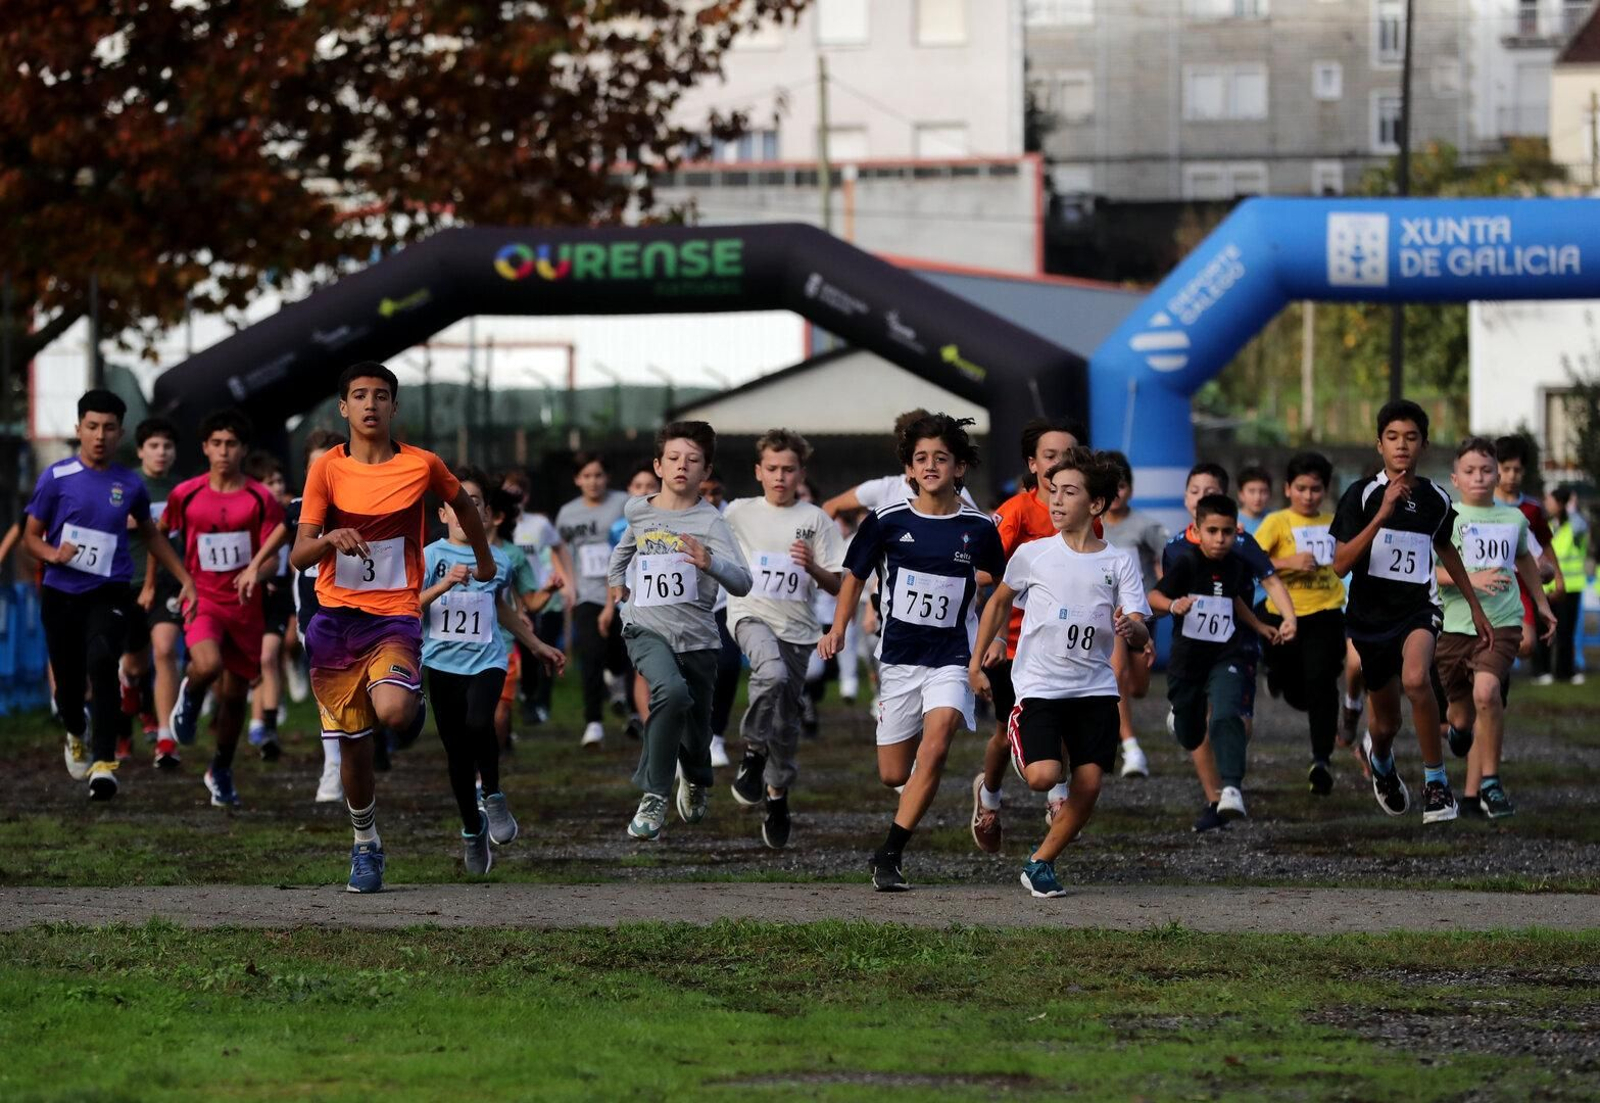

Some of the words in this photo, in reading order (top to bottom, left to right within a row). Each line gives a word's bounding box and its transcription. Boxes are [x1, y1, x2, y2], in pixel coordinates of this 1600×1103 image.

[1401, 216, 1510, 245] XUNTA
[494, 238, 744, 280] OURENSE
[1401, 248, 1441, 277] DE
[1447, 245, 1581, 277] GALICIA
[75, 544, 98, 567] 75
[209, 546, 241, 565] 411
[1389, 548, 1416, 574] 25
[1475, 538, 1510, 561] 300
[362, 558, 376, 582] 3
[761, 570, 799, 594] 779
[643, 572, 685, 599] 763
[906, 590, 949, 620] 753
[441, 609, 481, 635] 121
[1197, 612, 1231, 636] 767
[1066, 624, 1096, 651] 98
